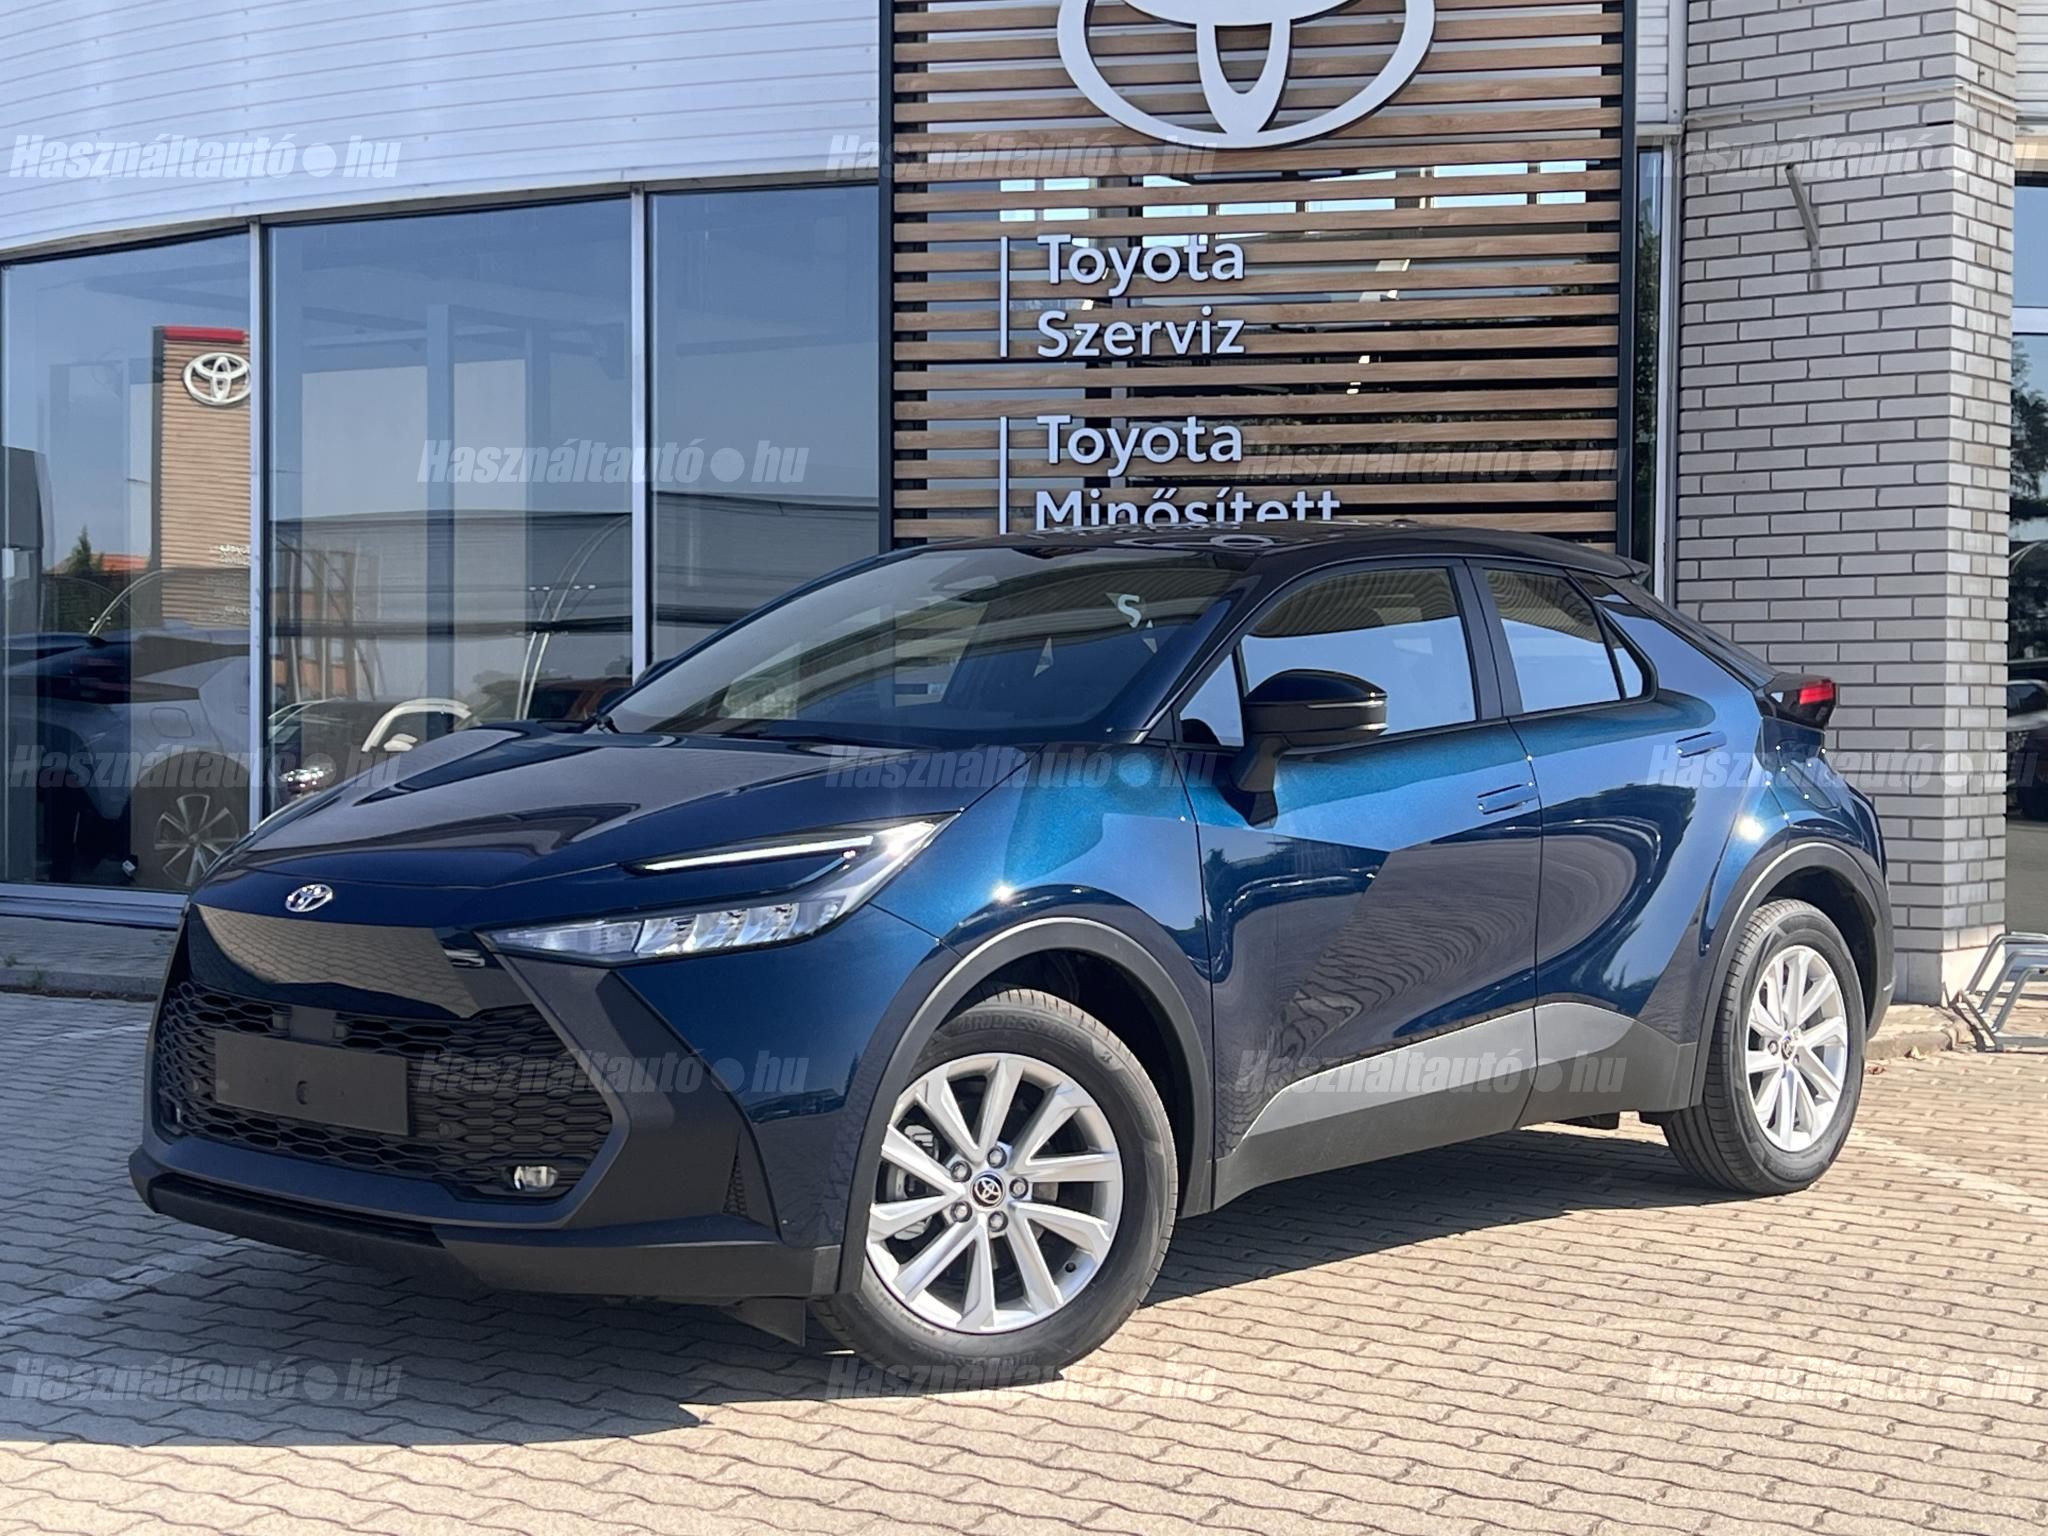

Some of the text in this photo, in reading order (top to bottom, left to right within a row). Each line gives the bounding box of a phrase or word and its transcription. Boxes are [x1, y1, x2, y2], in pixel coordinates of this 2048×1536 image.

[1037, 233, 1244, 296] Toyota
[1038, 305, 1245, 357] Szerviz
[1037, 414, 1242, 477] Toyota
